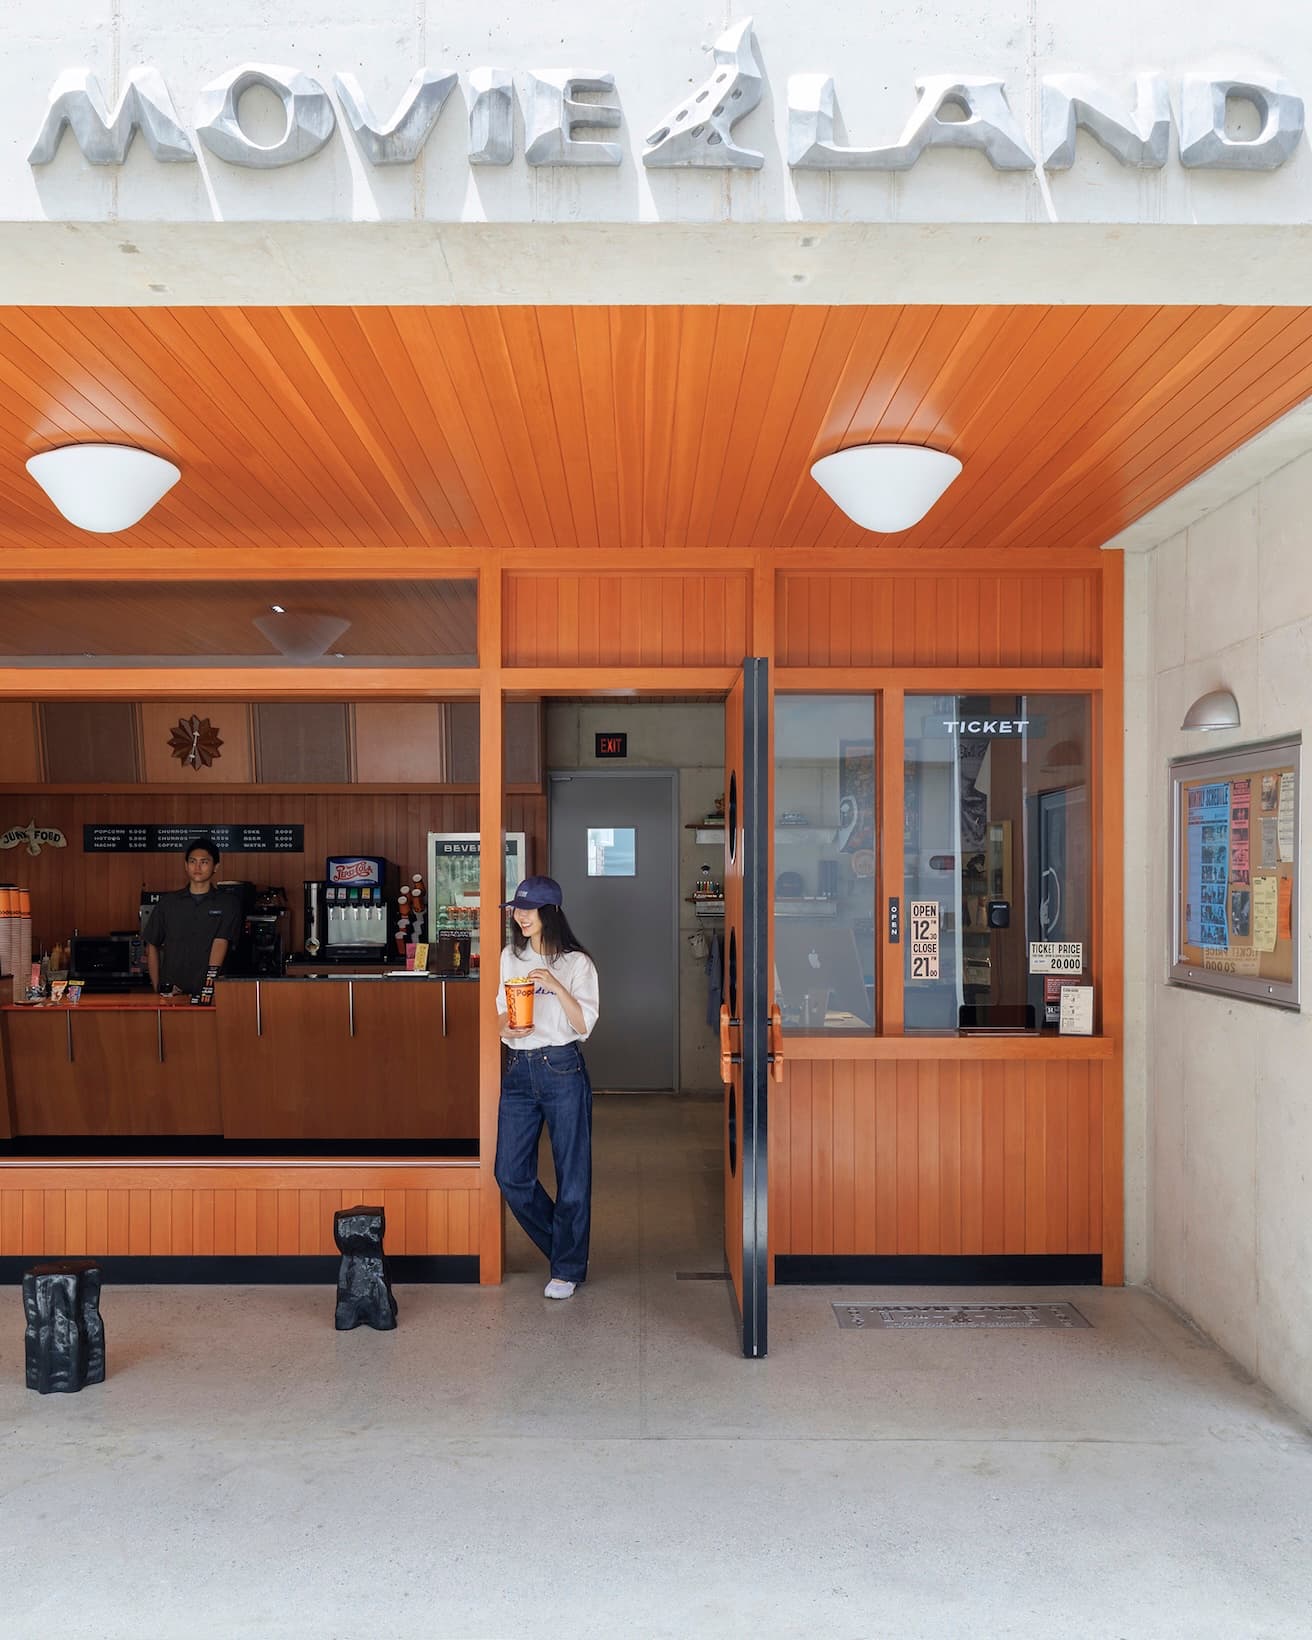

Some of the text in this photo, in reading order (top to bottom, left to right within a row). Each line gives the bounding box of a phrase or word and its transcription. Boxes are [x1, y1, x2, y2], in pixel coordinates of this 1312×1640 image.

[27, 63, 1305, 171] MOVIE LAND
[943, 721, 1029, 734] TICKET
[600, 737, 622, 753] EXIT
[34, 830, 61, 842] FOOD
[913, 905, 936, 917] OPEN
[890, 906, 898, 935] OPEN
[913, 920, 929, 940] 12
[913, 943, 937, 953] CLOSE
[1031, 944, 1080, 954] TICKET PRICE
[913, 957, 929, 977] 21
[1051, 958, 1080, 970] 20,000
